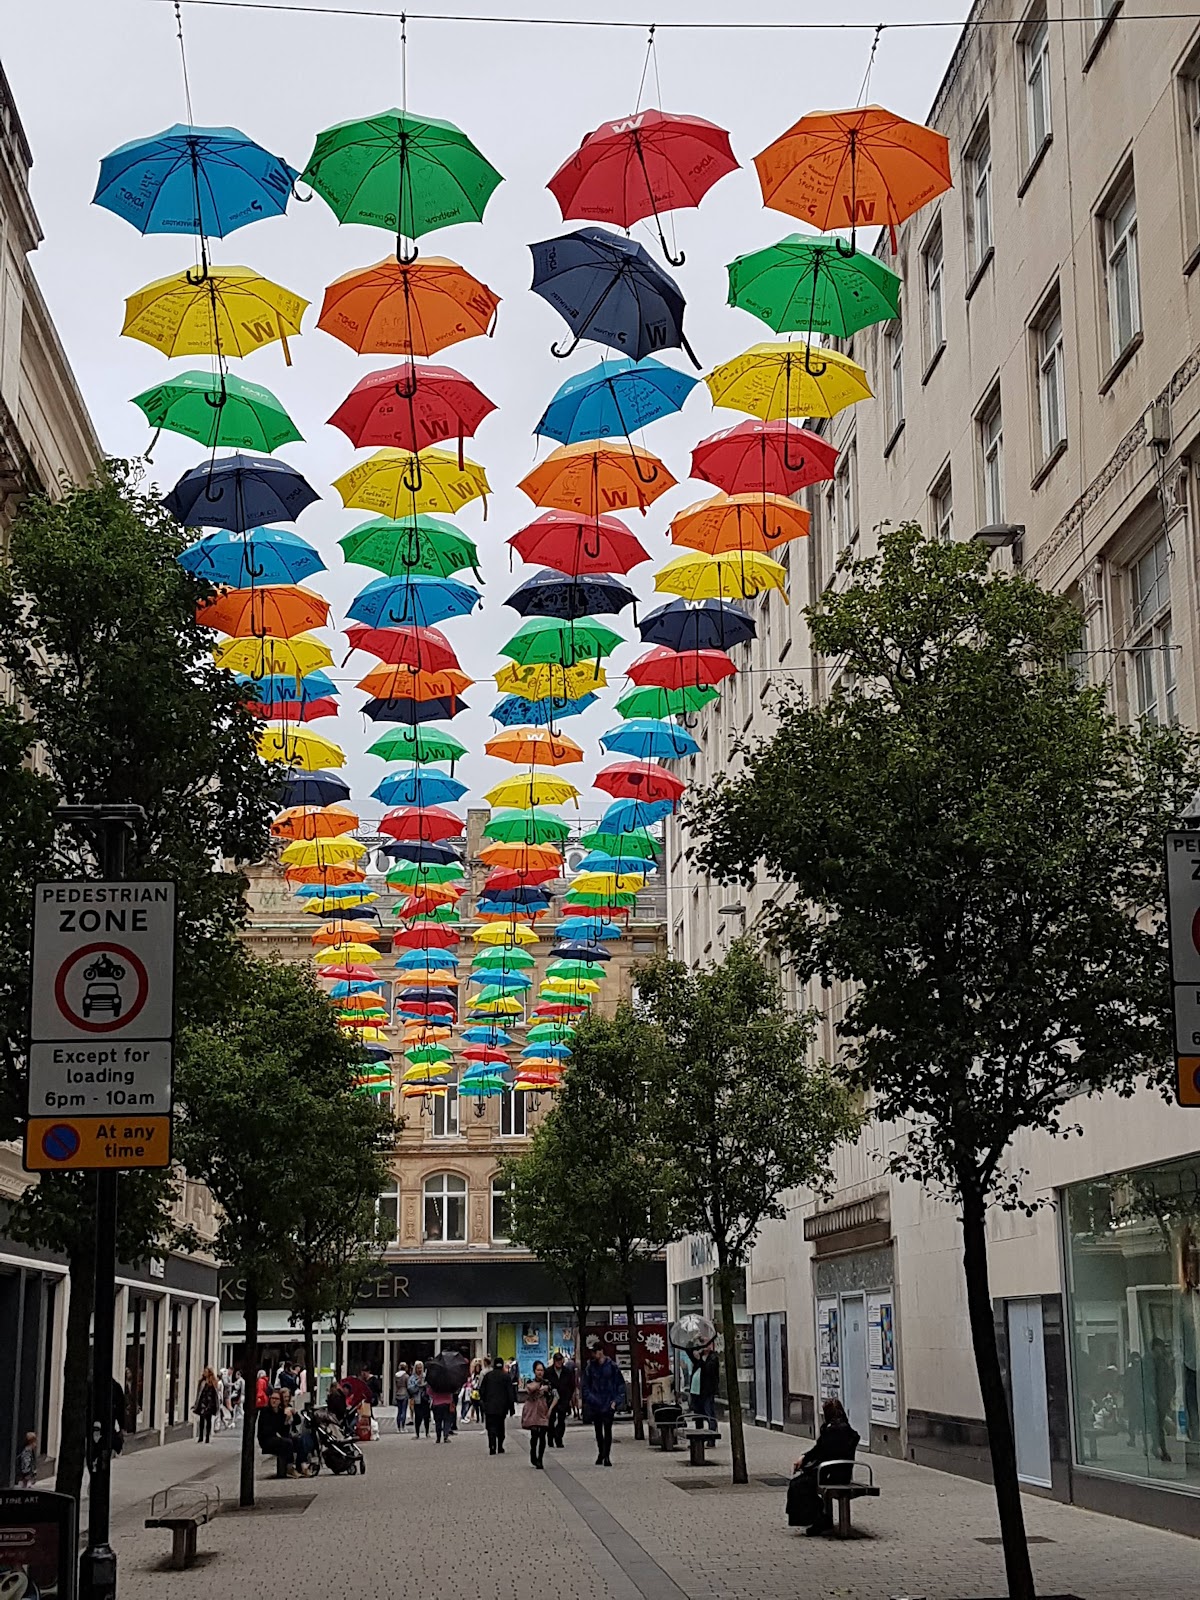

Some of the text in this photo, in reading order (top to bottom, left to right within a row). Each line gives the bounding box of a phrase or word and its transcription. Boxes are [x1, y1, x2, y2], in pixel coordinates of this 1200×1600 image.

[43, 887, 168, 903] PEDESTRIAN
[59, 909, 148, 932] ZONE
[53, 1049, 150, 1067] Except for
[67, 1069, 135, 1085] loading
[45, 1091, 85, 1108] 6pm
[106, 1090, 155, 1105] 10am
[96, 1125, 155, 1141] At any
[105, 1143, 145, 1157] time
